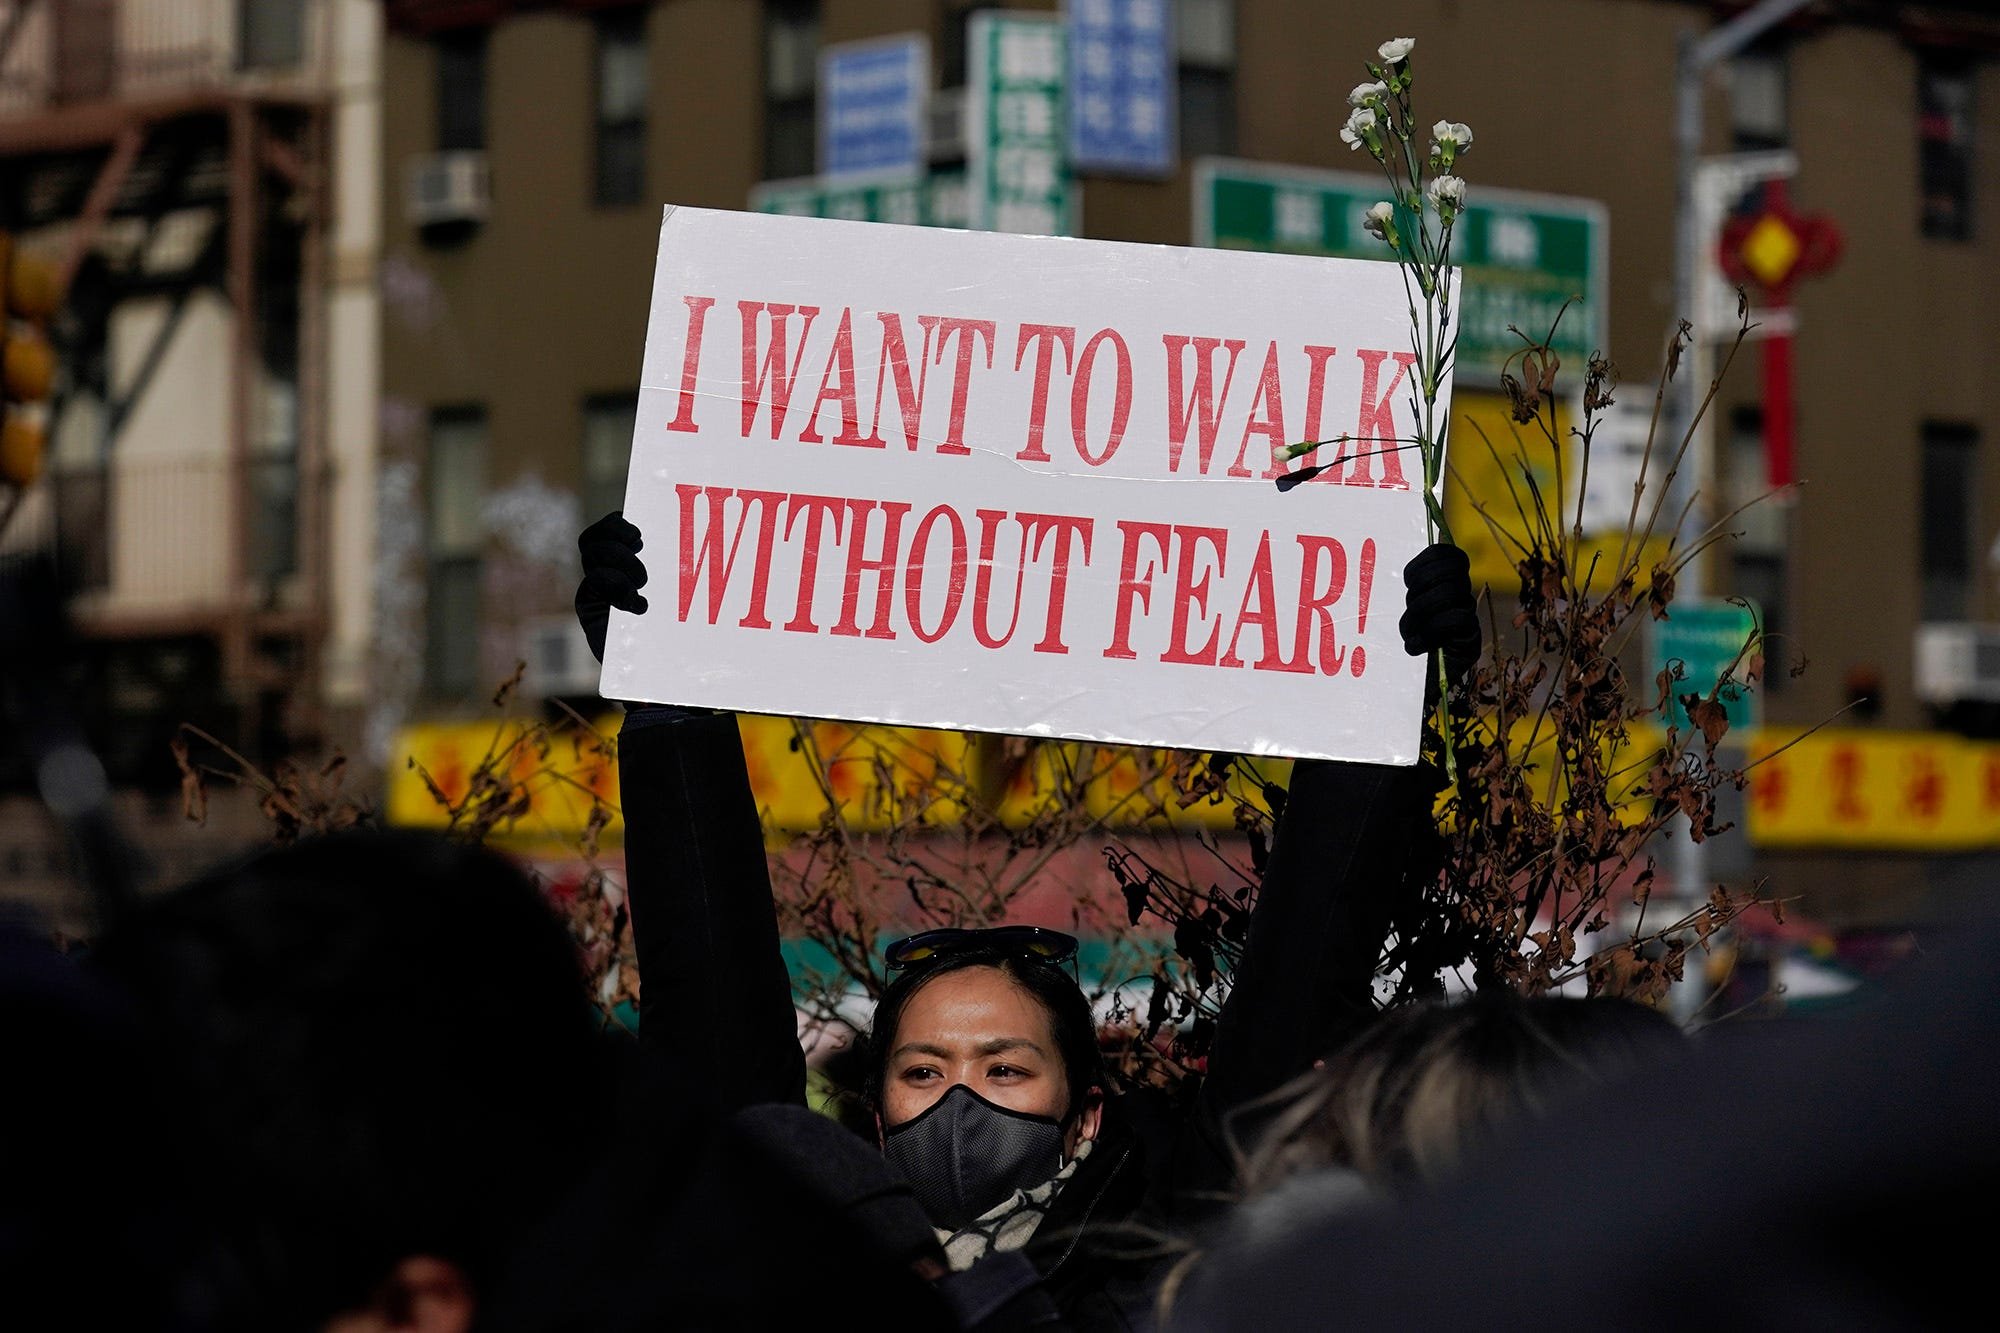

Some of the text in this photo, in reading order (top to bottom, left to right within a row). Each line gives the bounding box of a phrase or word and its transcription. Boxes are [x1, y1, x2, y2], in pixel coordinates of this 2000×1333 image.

[667, 297, 1416, 490] I WANT TO WALK
[675, 484, 1376, 677] WITHOUT FEAR!
